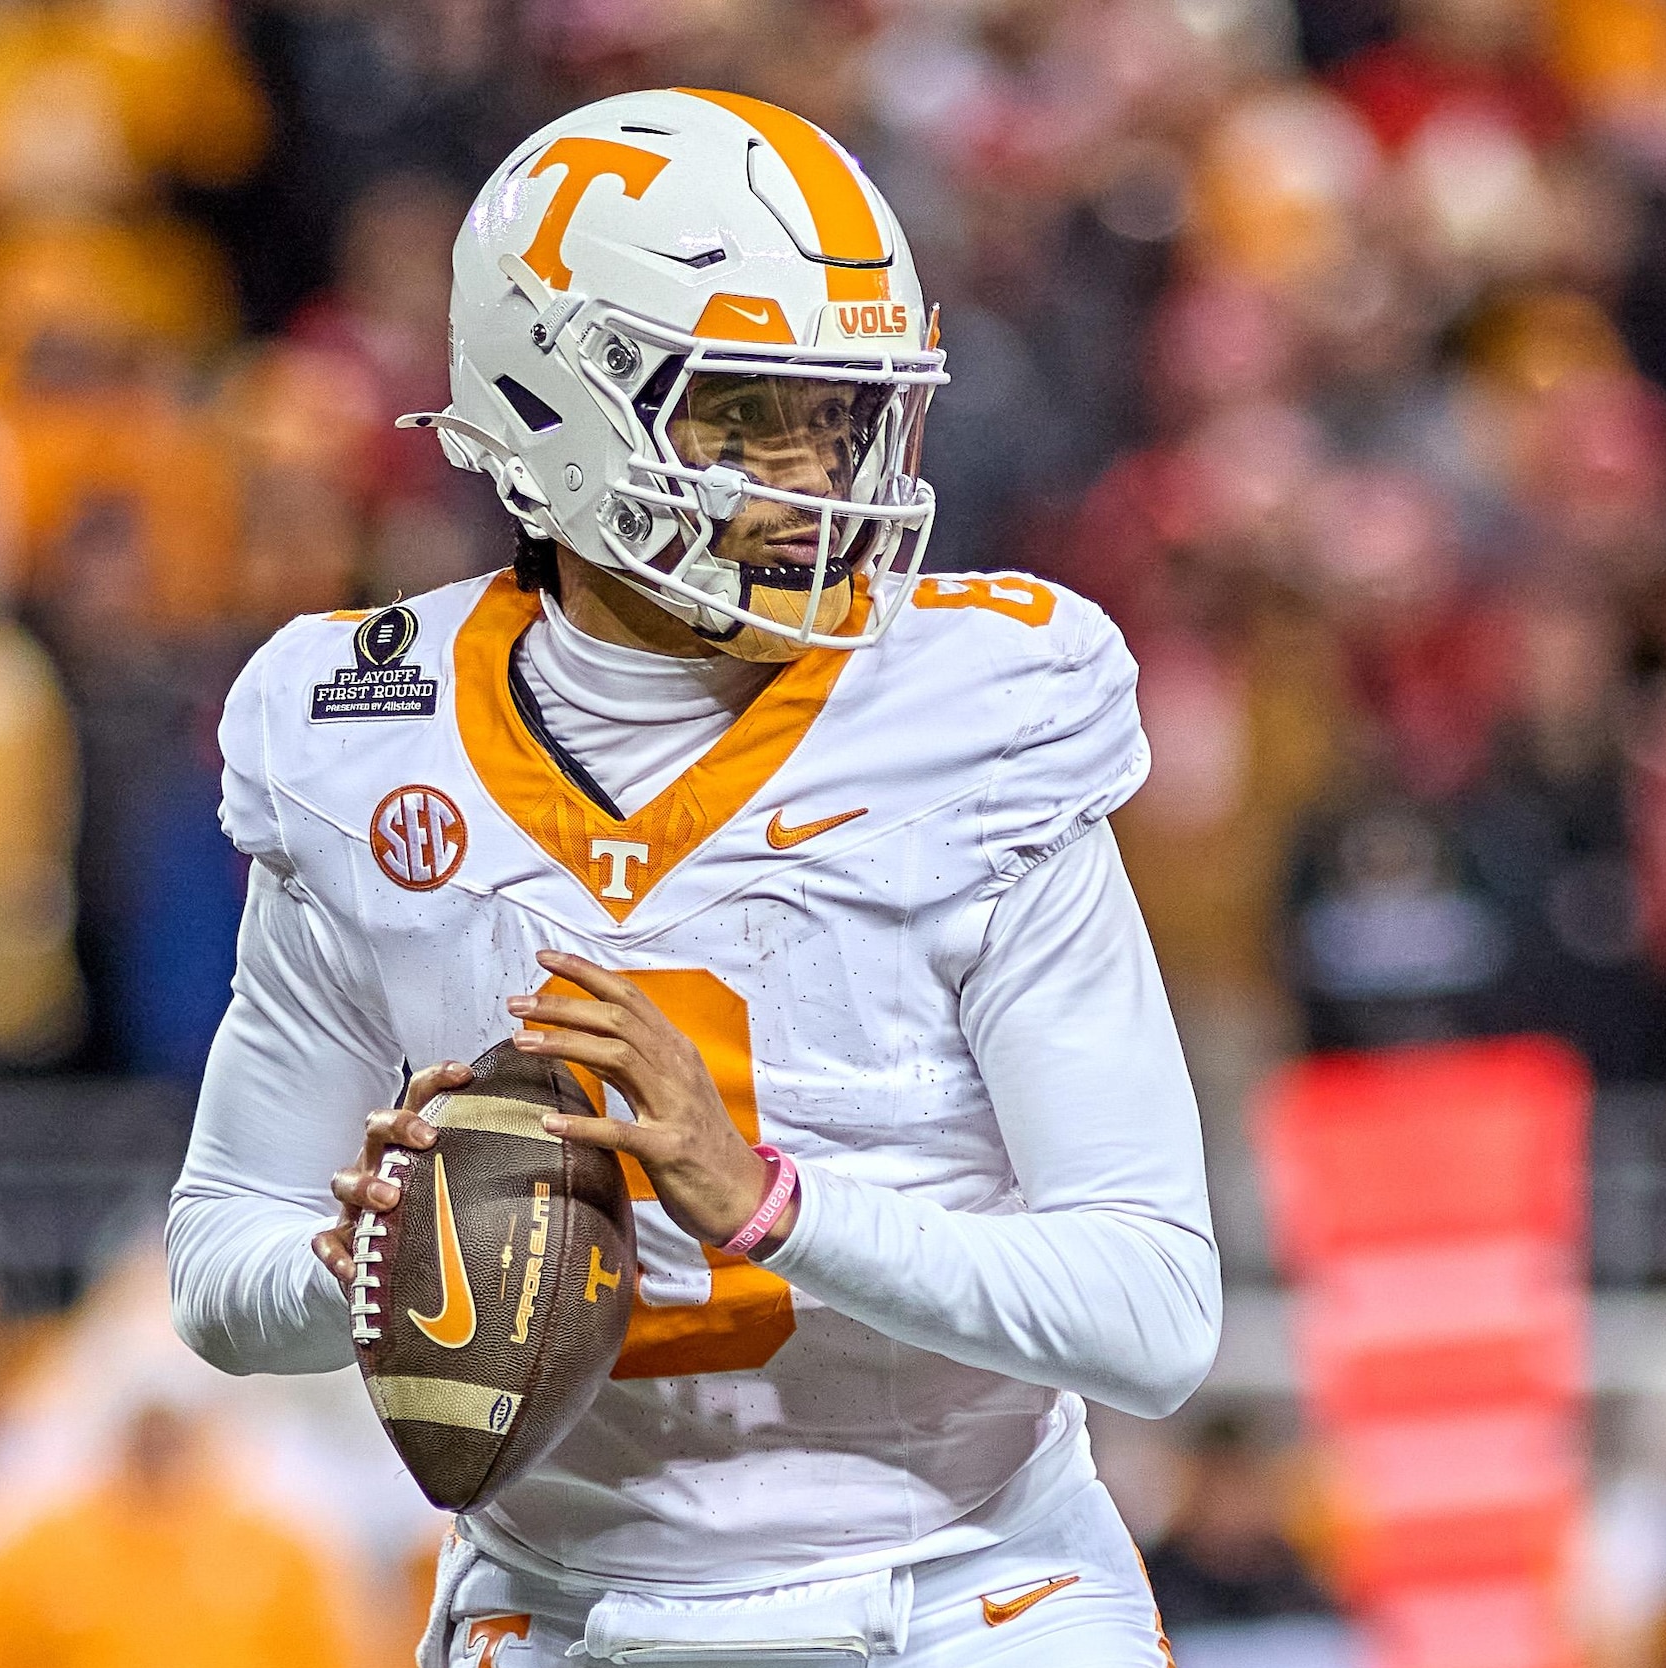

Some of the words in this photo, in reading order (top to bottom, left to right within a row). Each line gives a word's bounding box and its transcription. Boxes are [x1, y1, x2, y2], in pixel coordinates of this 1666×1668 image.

[511, 137, 673, 292] T
[838, 305, 908, 335] VOLS
[317, 685, 370, 702] FIRST
[372, 683, 434, 699] ROUND
[337, 668, 417, 686] PLAYOFF
[325, 702, 370, 713] PRESENTED
[371, 702, 383, 711] BY
[383, 700, 422, 712] Allstate
[377, 792, 460, 882] SEC
[591, 839, 650, 901] T
[757, 1180, 795, 1224] Team
[510, 1257, 544, 1345] VAPOR
[529, 1181, 551, 1256] ELITE
[584, 1244, 622, 1304] T
